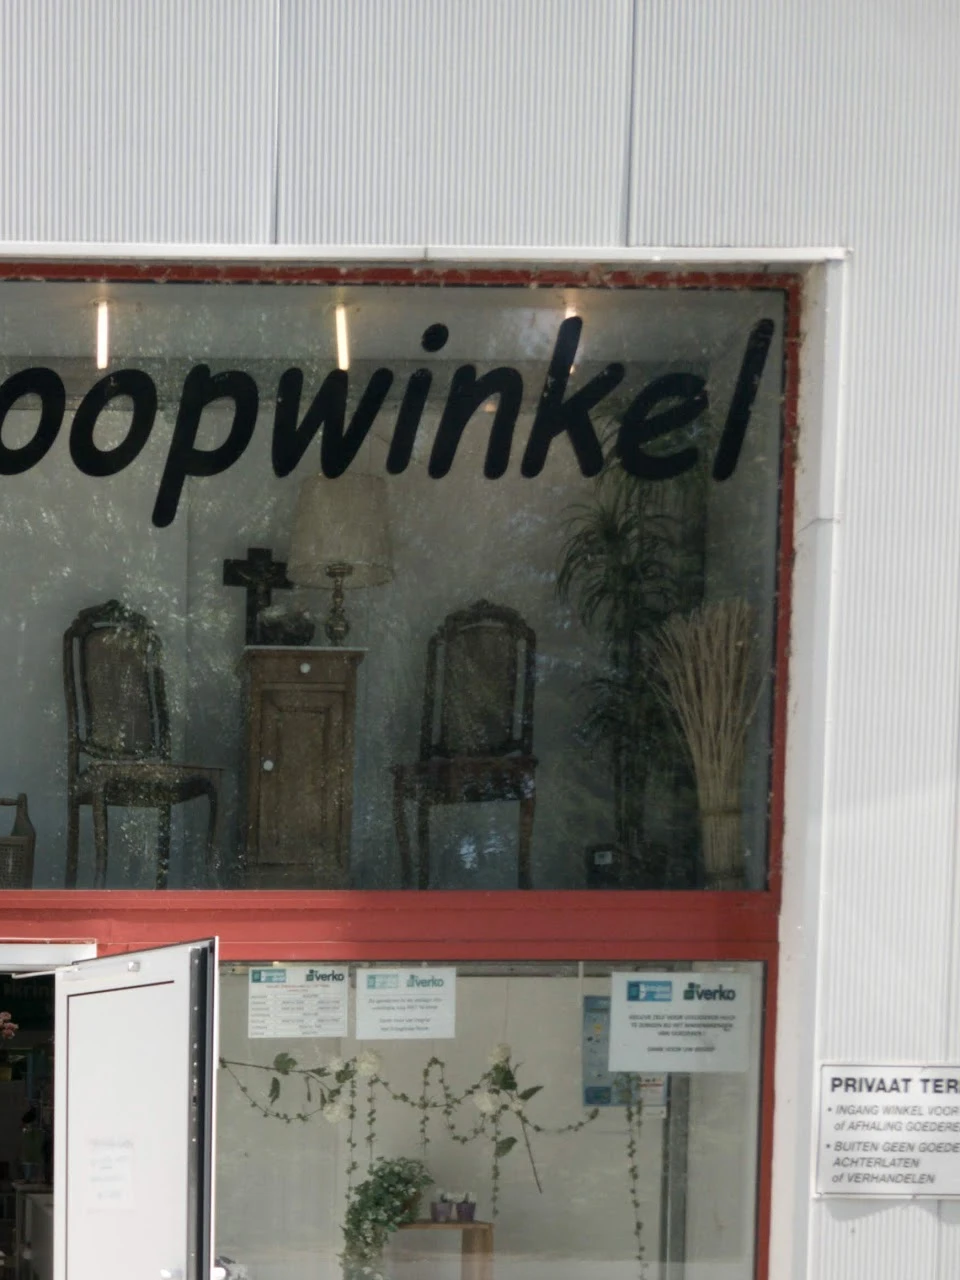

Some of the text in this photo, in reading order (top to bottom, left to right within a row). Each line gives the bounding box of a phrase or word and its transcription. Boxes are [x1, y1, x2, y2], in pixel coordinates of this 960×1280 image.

[830, 1077, 960, 1094] PRIVAAT TER
[835, 1104, 960, 1116] INGANG WINKEL VOOR
[834, 1121, 960, 1132] of AFHALING GOEDERE
[833, 1141, 960, 1153] BUITEN GEEN GOEDE
[832, 1157, 920, 1168] ACHTERLATEN
[832, 1173, 936, 1184] of VERHANDELEN
